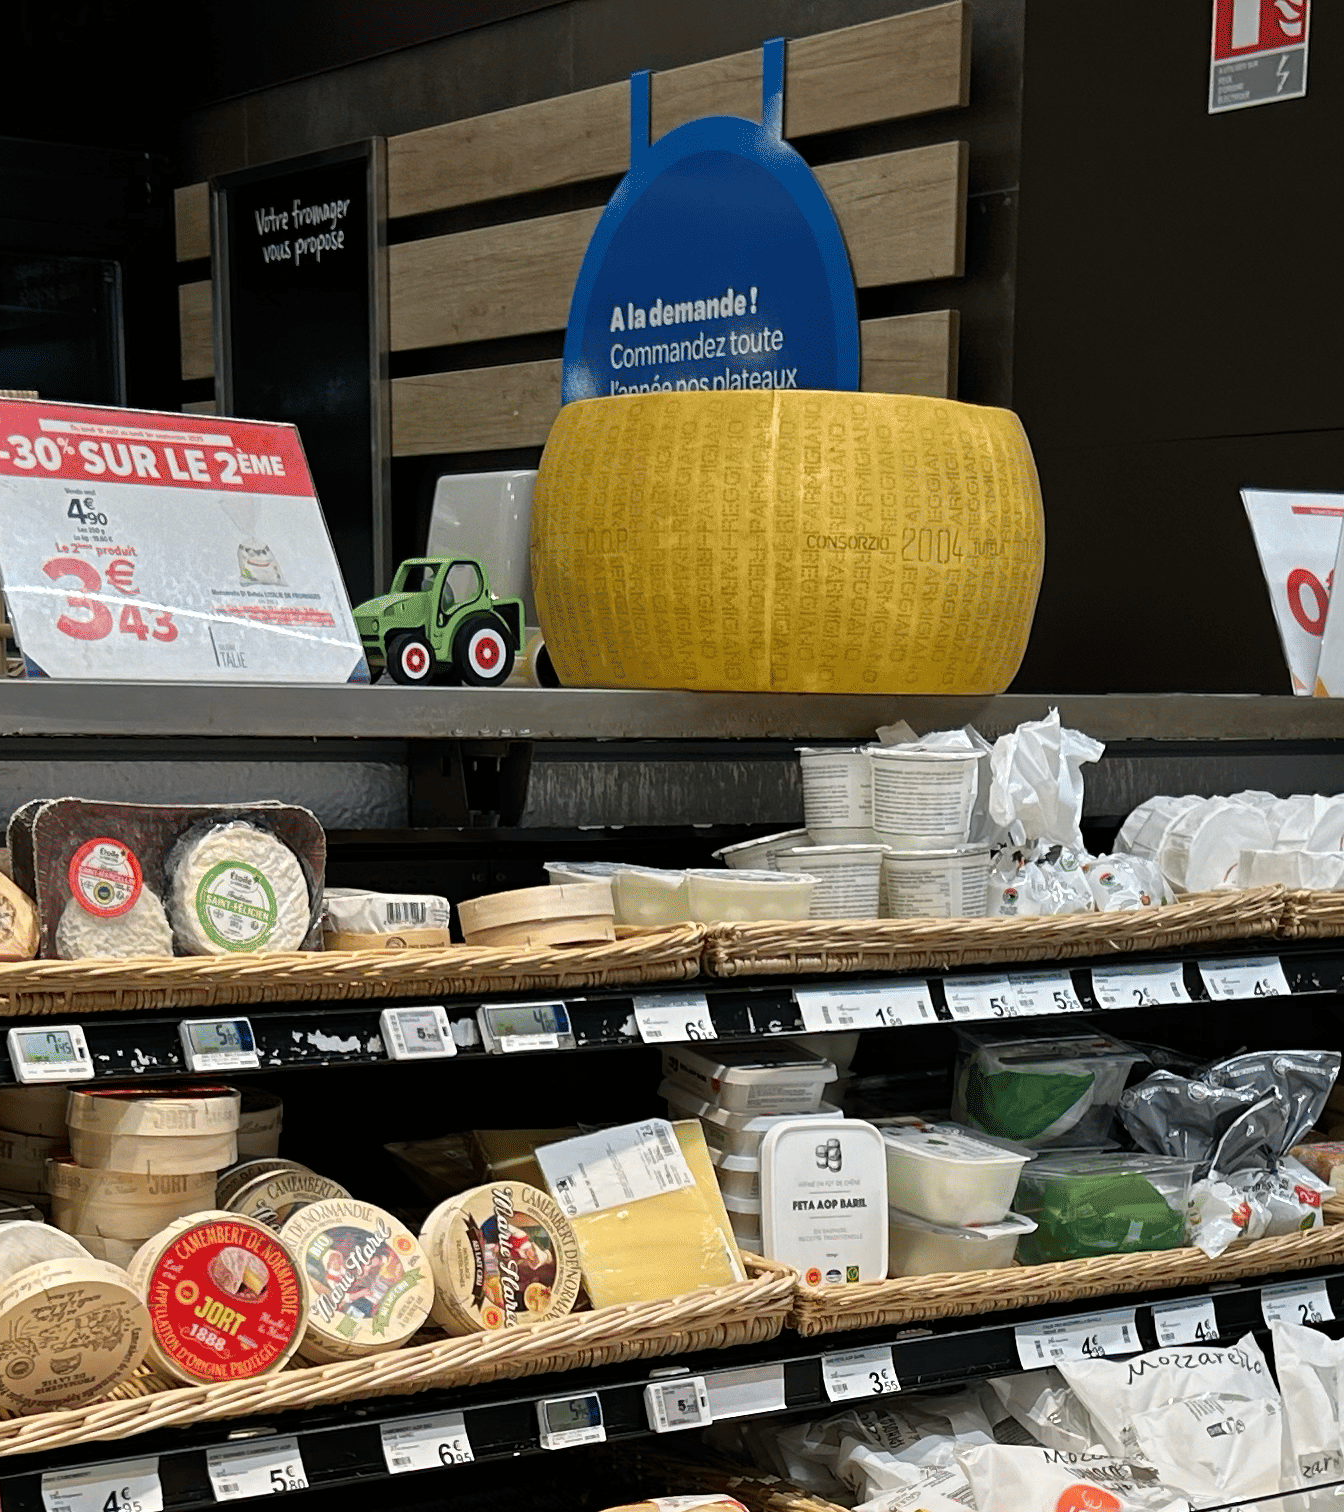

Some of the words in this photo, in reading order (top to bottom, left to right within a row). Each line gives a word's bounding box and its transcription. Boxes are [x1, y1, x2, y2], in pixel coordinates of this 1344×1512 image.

[255, 206, 289, 236] Votre
[292, 198, 350, 230] fromager
[262, 240, 292, 263] vous
[294, 230, 344, 266] propose
[610, 306, 625, 332] A
[628, 302, 646, 330] la
[649, 287, 747, 328] demande
[610, 331, 726, 369] Commandez
[730, 327, 784, 355] toute
[713, 367, 798, 390] plateaux
[79, 440, 162, 480] SUR
[164, 447, 211, 483] LE
[95, 545, 138, 557] produit
[806, 533, 890, 551] CONSORZIO
[901, 527, 964, 564] 2004
[152, 1109, 198, 1129] JORT
[147, 1173, 188, 1195] JORT
[307, 1201, 375, 1227] NORMANDIE
[492, 1184, 514, 1259] Marie
[521, 1190, 570, 1251] CAMEMBERT
[792, 1199, 816, 1212] FETA
[817, 1198, 838, 1211] AOP
[308, 1235, 330, 1260] BIO
[174, 1225, 245, 1260] CAMEMBERT
[245, 1229, 262, 1250] DE
[261, 1241, 297, 1316] NORMANDIE
[310, 1267, 354, 1323] Marie
[346, 1217, 392, 1278] Harel
[153, 1280, 179, 1356] APPELLATION
[193, 1296, 248, 1337] JORT
[187, 1321, 228, 1354] 1888
